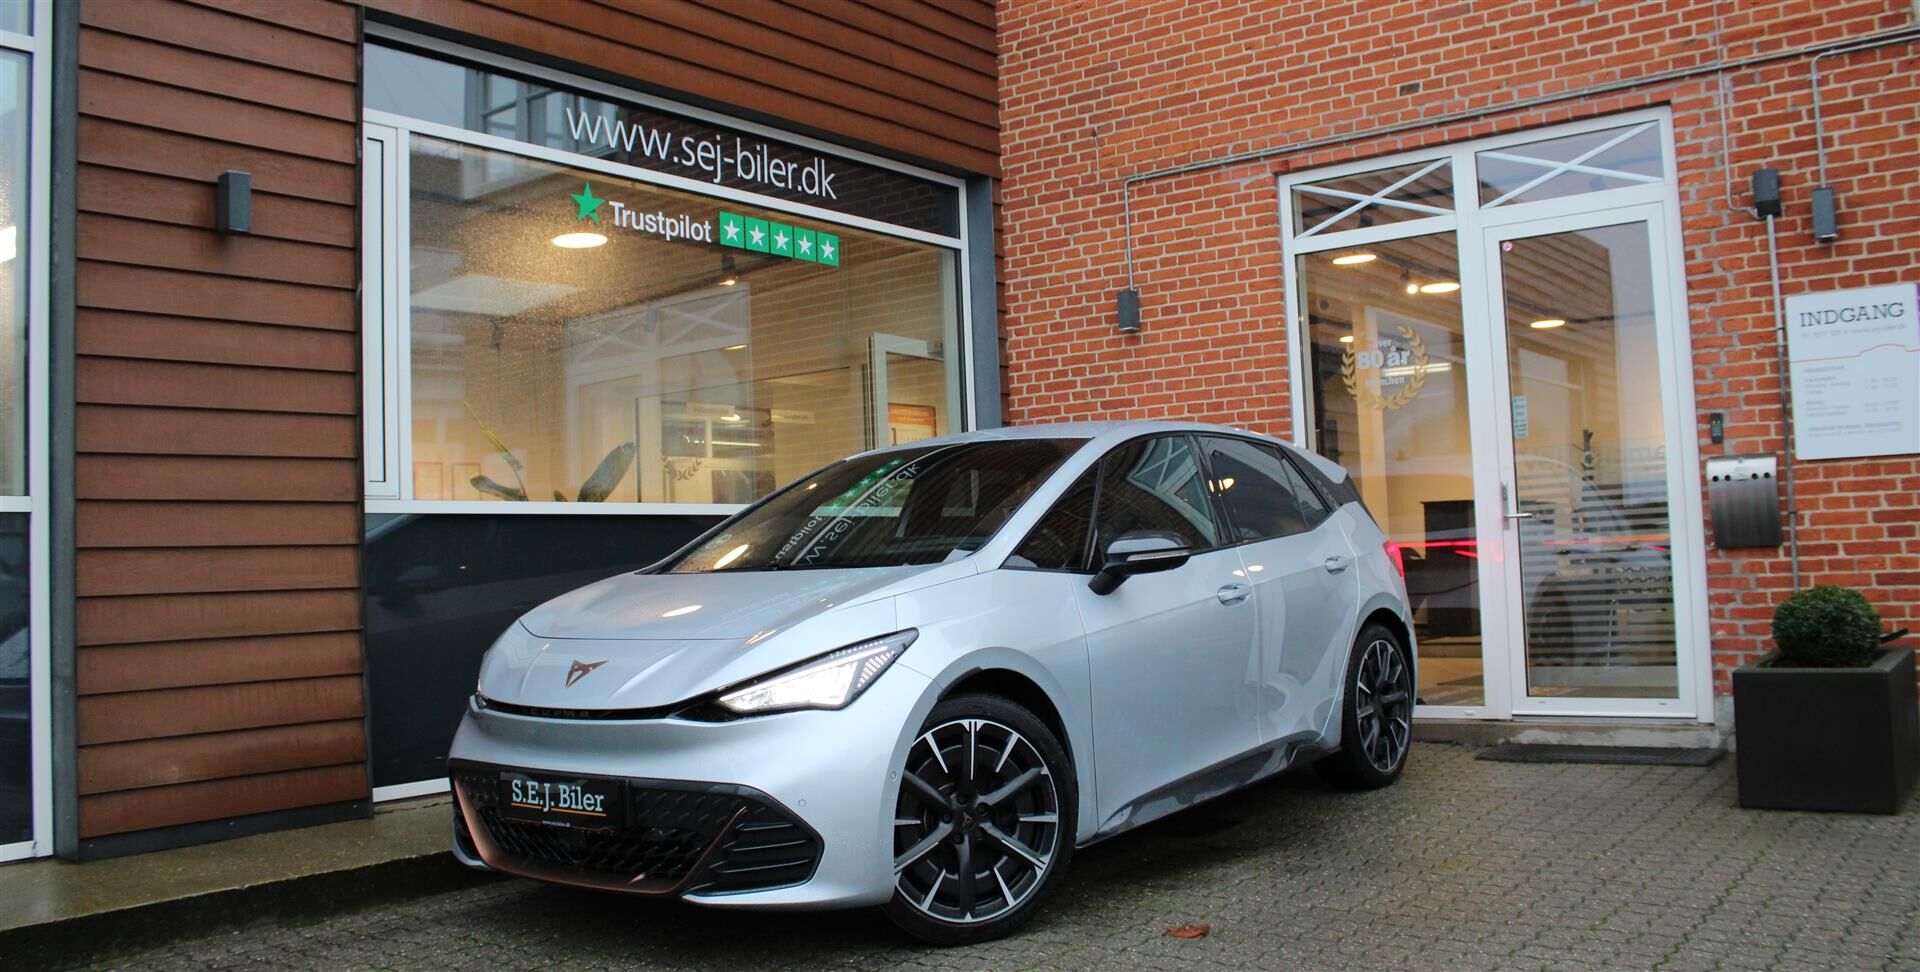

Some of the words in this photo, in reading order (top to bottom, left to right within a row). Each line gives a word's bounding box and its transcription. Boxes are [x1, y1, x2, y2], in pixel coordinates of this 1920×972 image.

[566, 108, 837, 200] www.sej-biler.dk
[609, 201, 712, 243] Trustpilot
[1800, 302, 1904, 327] INDGANG
[1357, 351, 1384, 369] 80
[1387, 346, 1410, 366] år
[512, 780, 555, 812] S.E.J.
[559, 784, 604, 812] Biler
